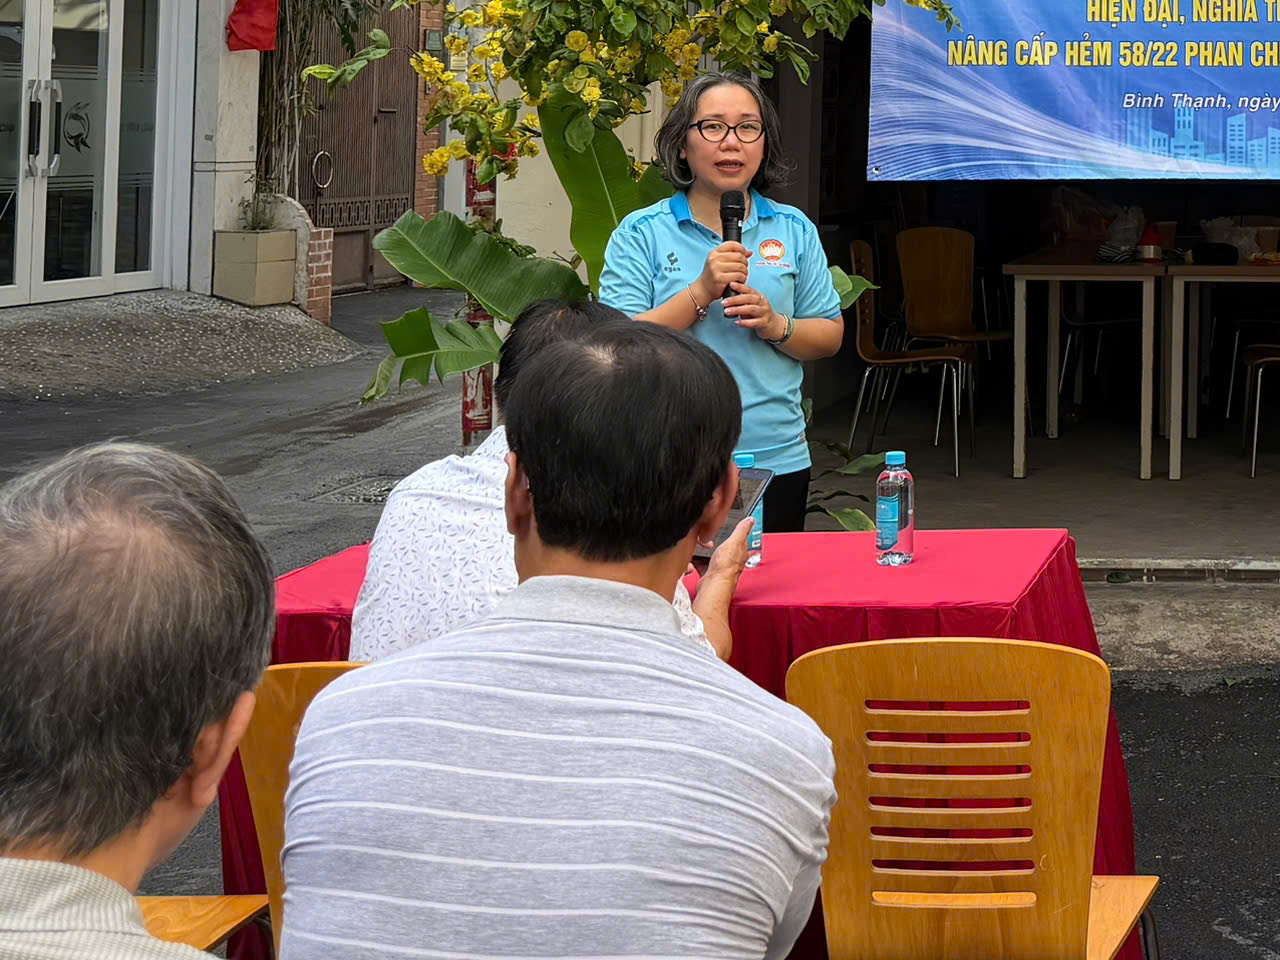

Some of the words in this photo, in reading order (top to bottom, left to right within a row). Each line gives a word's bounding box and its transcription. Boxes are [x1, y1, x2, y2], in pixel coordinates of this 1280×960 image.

[948, 35, 1008, 66] NÂNG
[1015, 32, 1058, 66] CẤP
[1065, 32, 1112, 66] HẺM
[1119, 41, 1178, 67] 58/22
[1185, 41, 1243, 67] PHAN
[1124, 94, 1163, 107] Bình
[1172, 94, 1230, 111] Thạnh,
[1239, 93, 1280, 111] ngày
